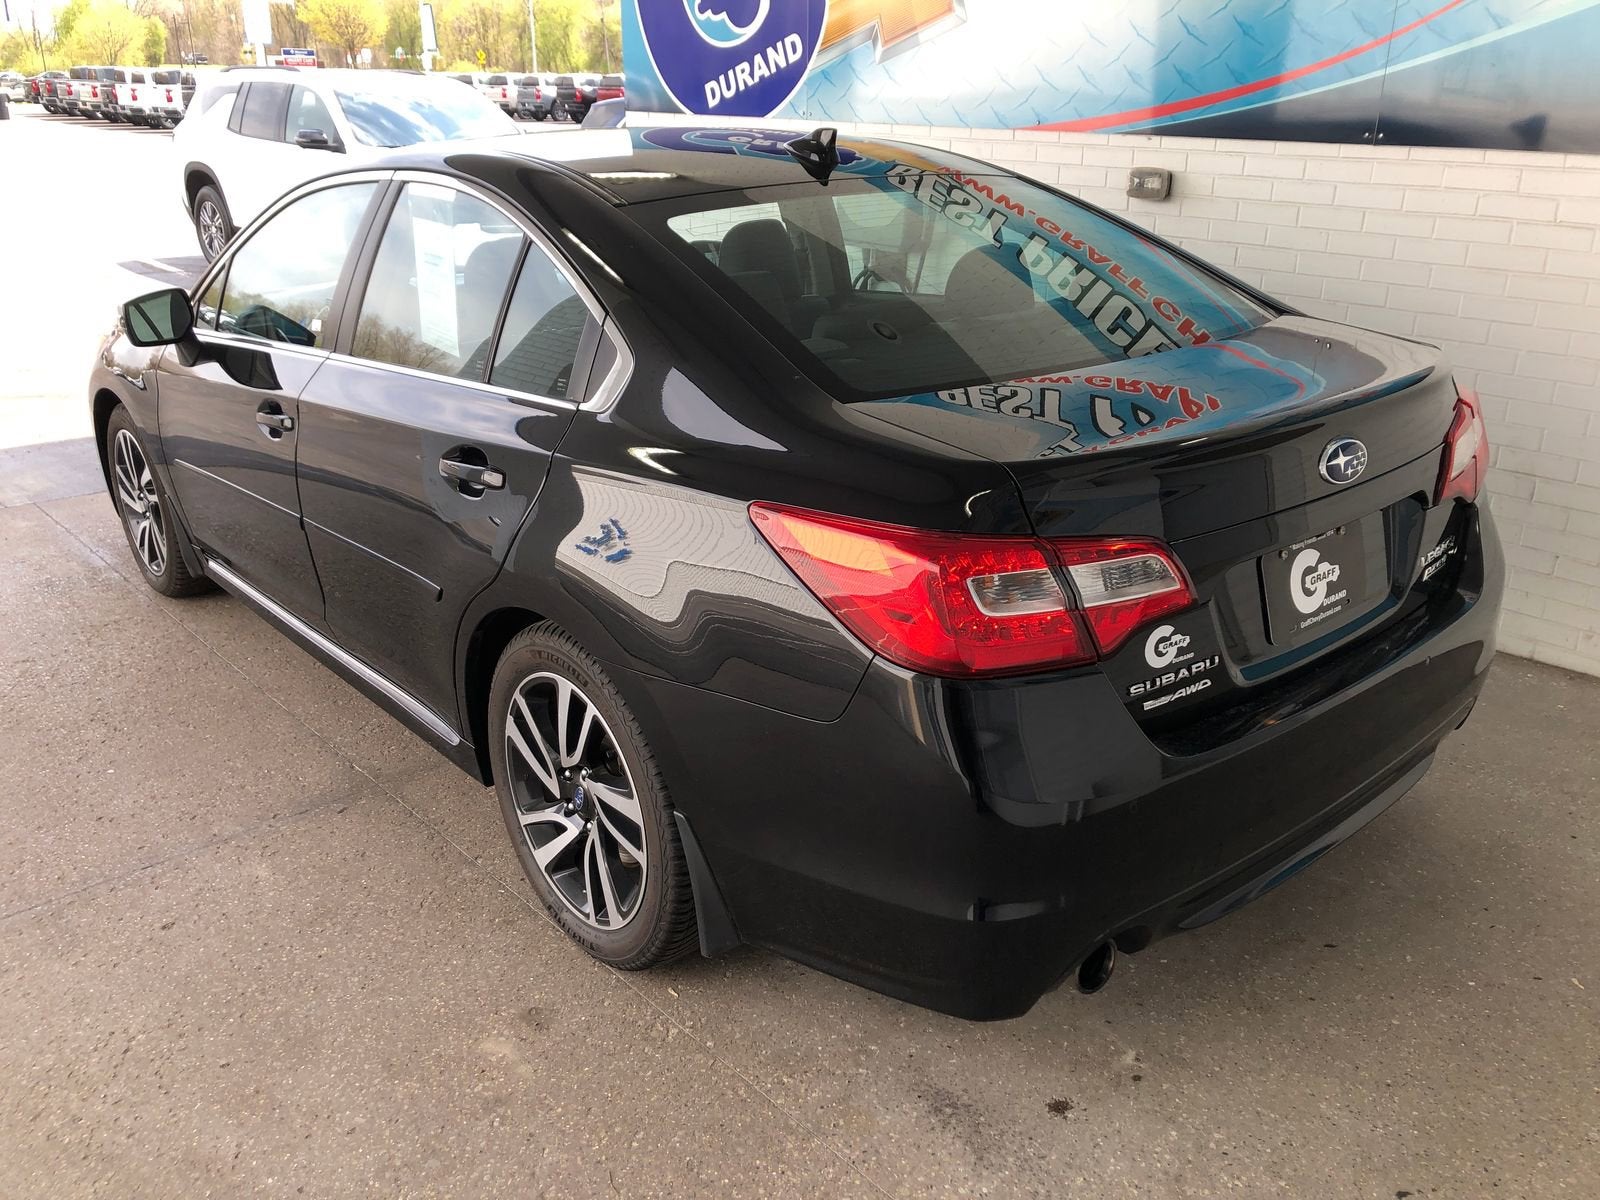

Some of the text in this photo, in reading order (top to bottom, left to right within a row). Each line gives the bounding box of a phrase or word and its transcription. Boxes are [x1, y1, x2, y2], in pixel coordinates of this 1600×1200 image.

[704, 32, 803, 109] DURAND
[1310, 567, 1337, 586] GRAFF
[1323, 589, 1347, 607] DURAND
[1162, 637, 1188, 650] GRAFF
[1129, 655, 1219, 697] SUBARU
[1170, 679, 1212, 701] AWD
